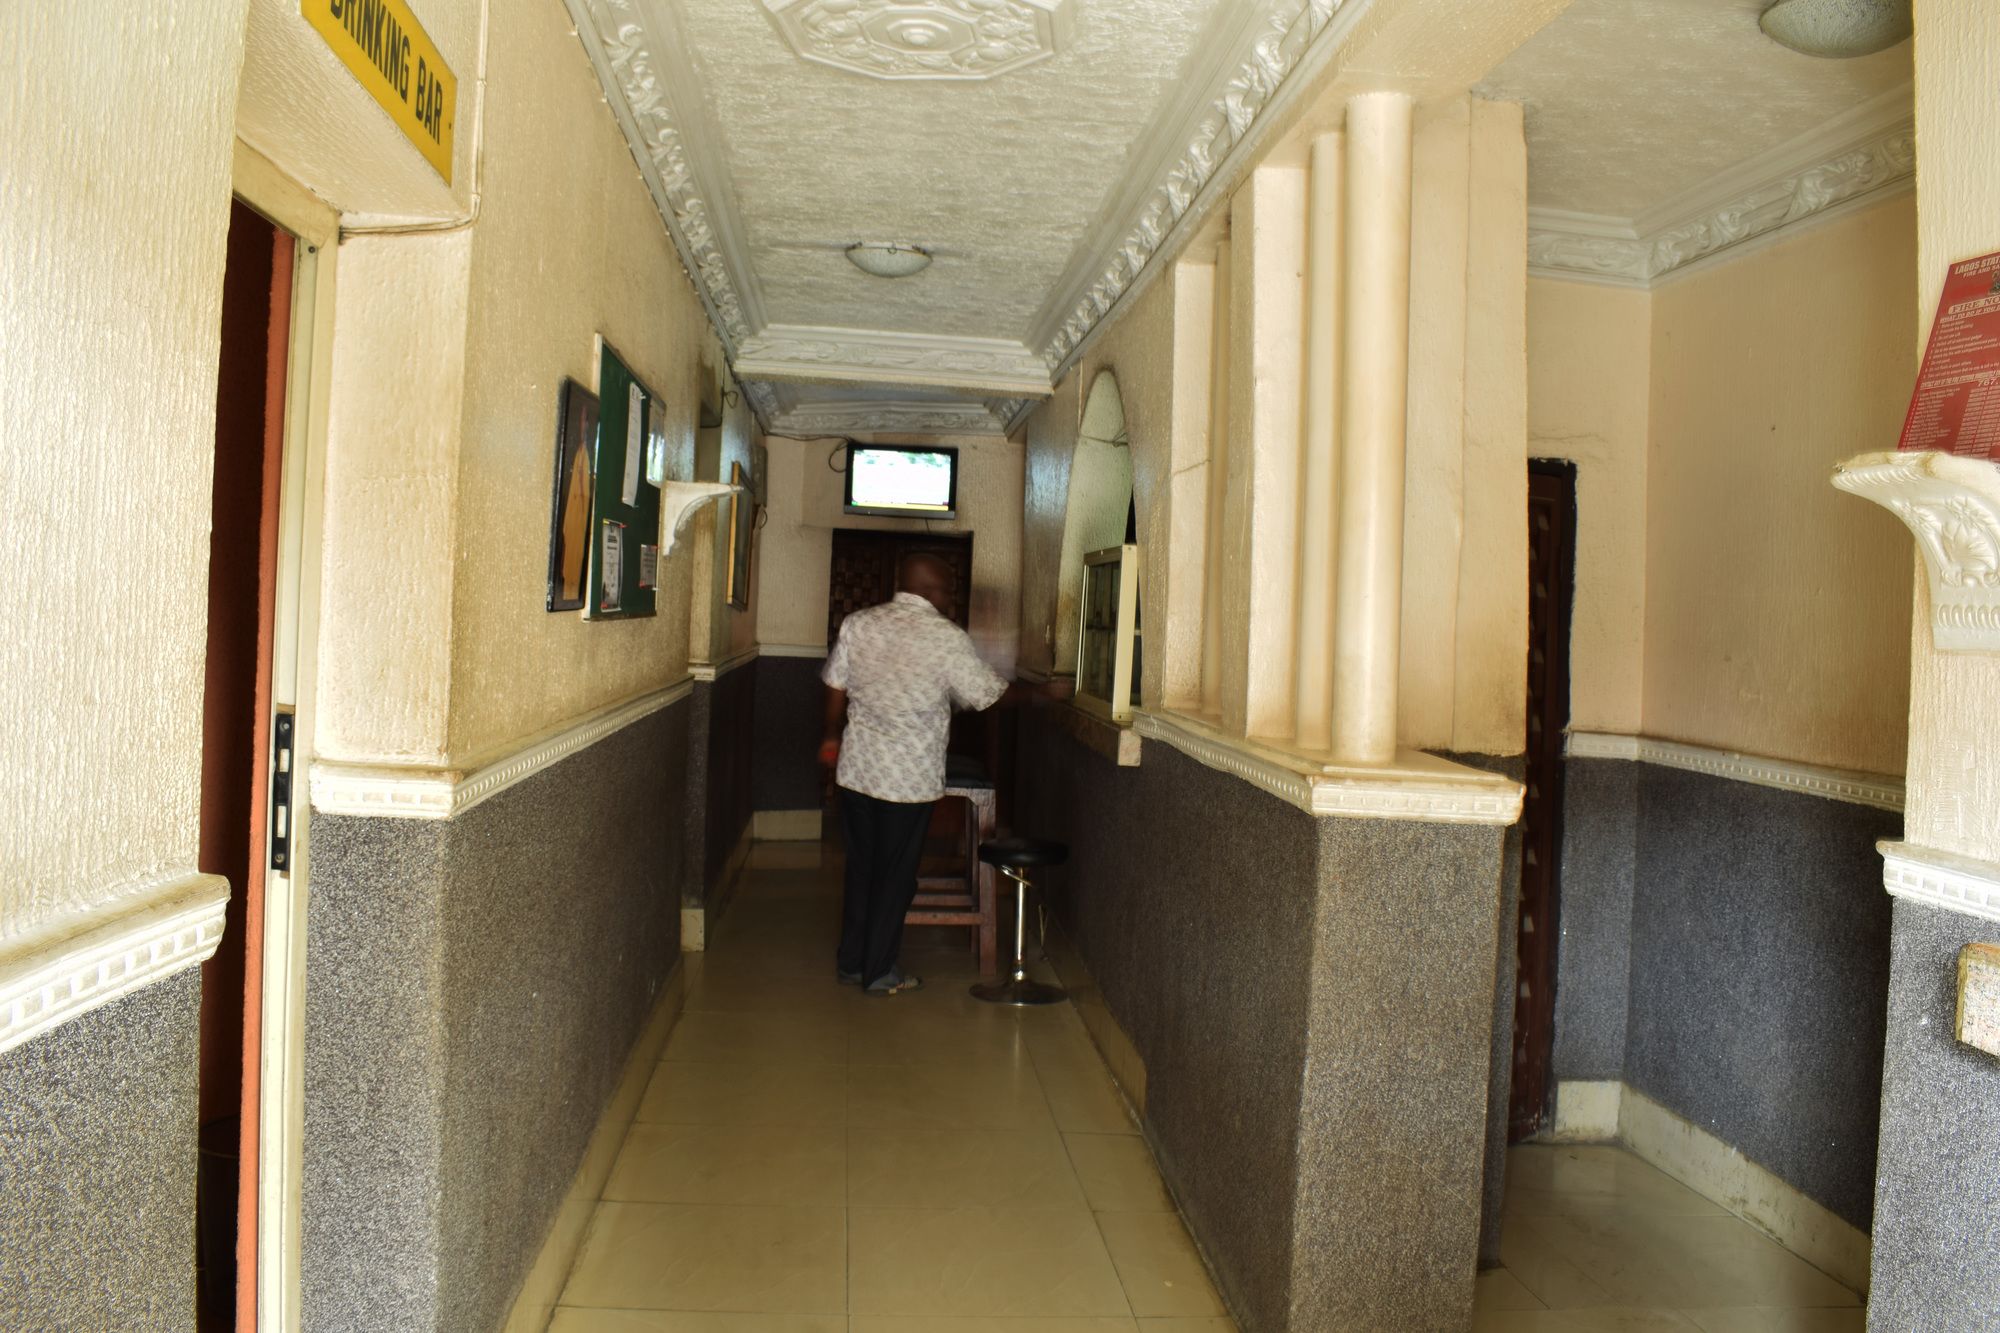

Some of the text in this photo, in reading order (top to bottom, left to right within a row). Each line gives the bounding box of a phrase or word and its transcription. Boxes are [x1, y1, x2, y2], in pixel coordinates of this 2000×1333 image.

[330, 0, 443, 145] RINKING BAR
[1954, 255, 2000, 275] LAGOS STAT
[1977, 267, 1990, 275] AND
[1952, 300, 1980, 313] FIRE
